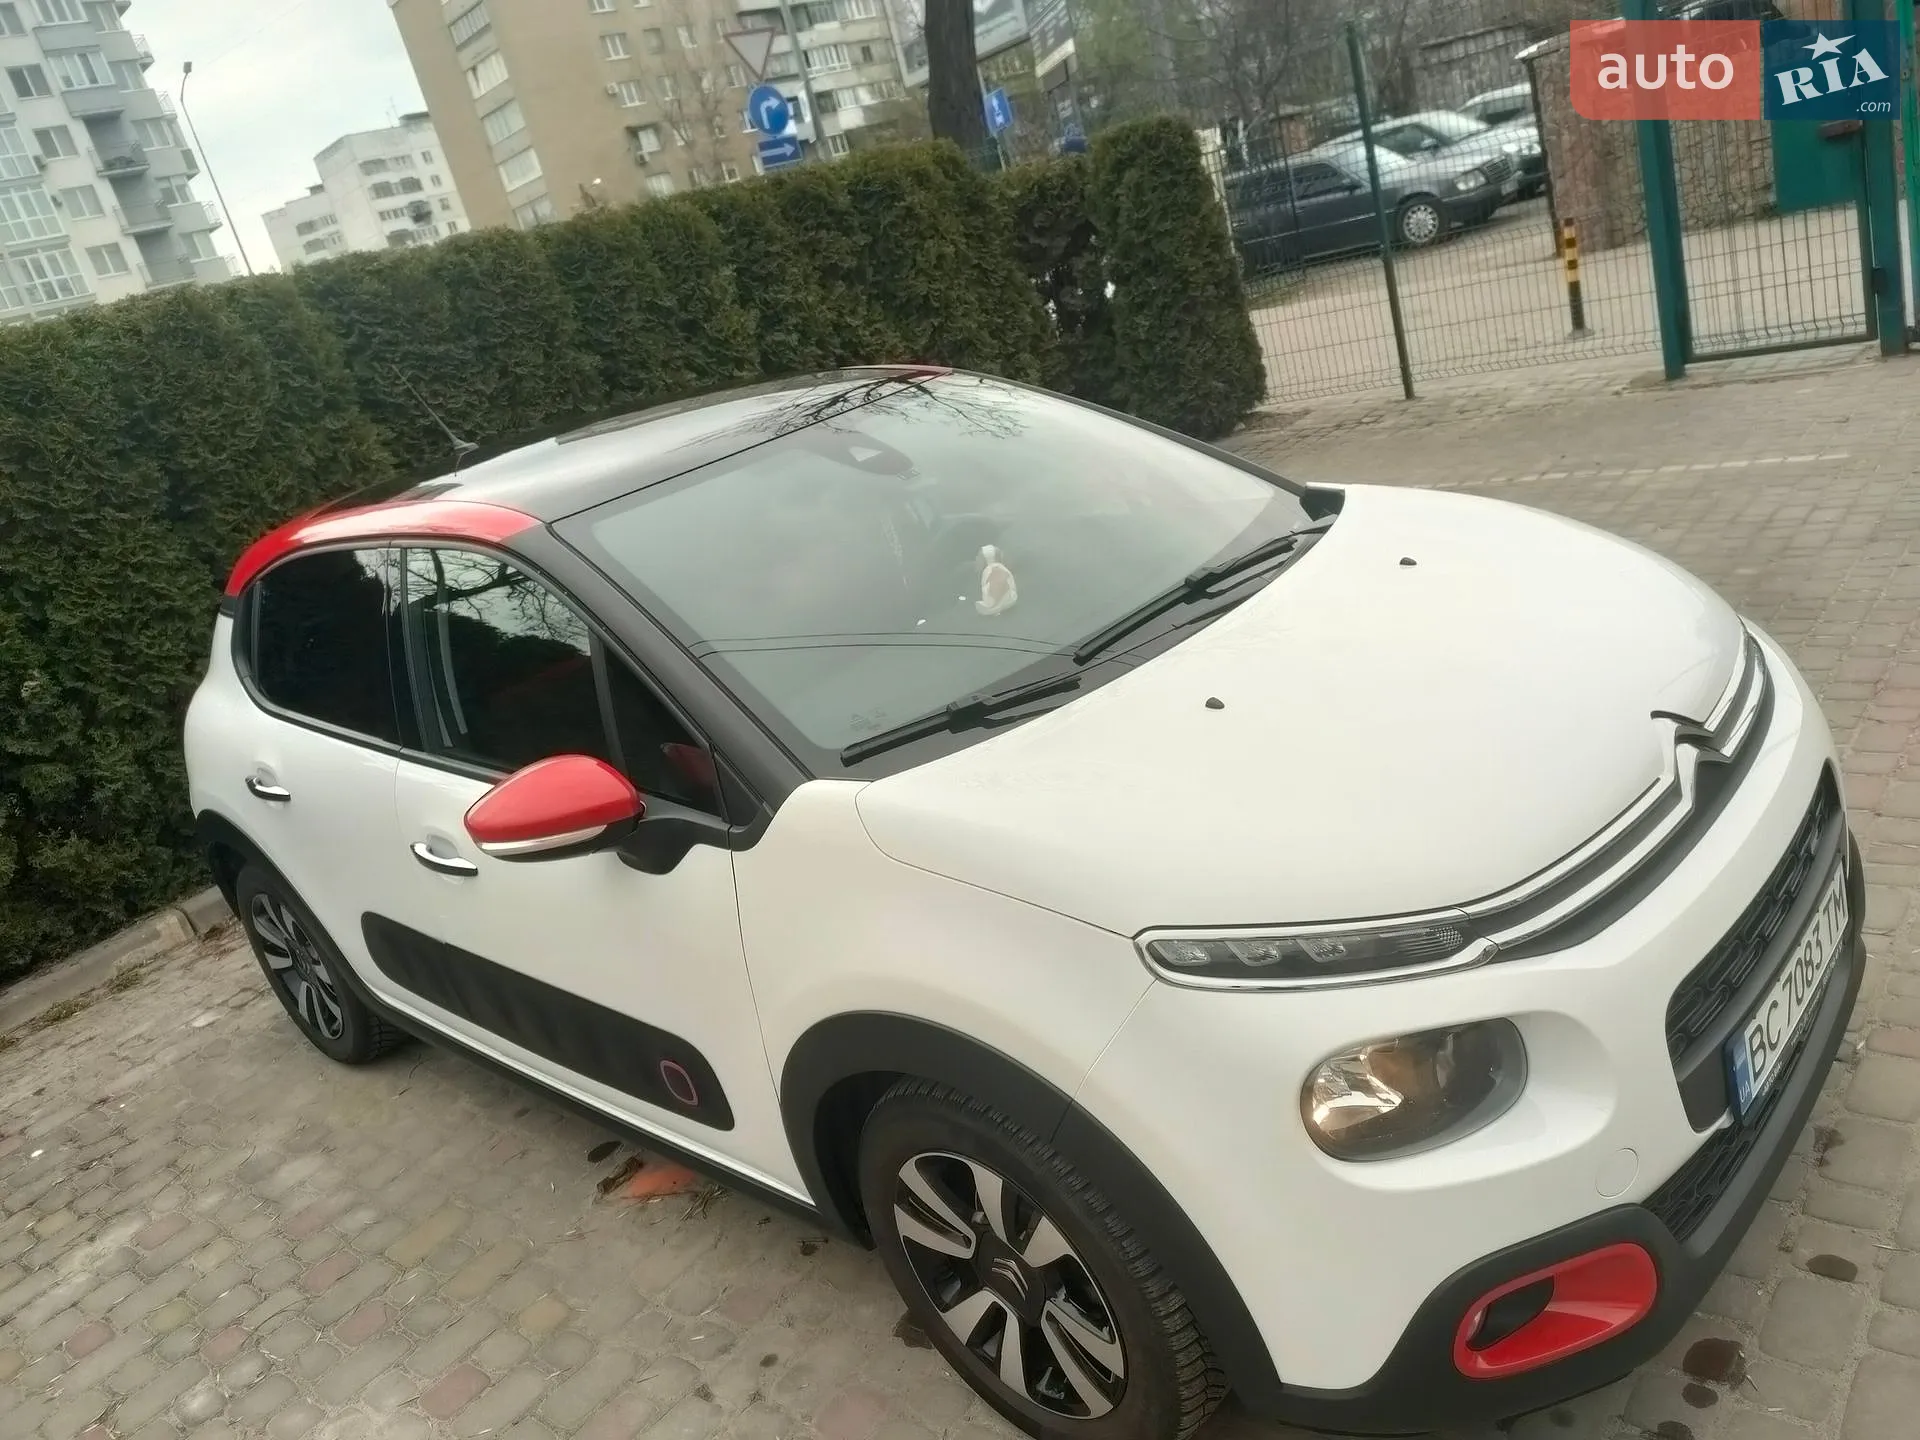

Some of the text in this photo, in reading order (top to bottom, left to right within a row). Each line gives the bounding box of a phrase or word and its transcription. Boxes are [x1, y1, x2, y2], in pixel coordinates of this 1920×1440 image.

[1749, 999, 1782, 1083] BC
[1782, 919, 1823, 1028] 7083
[1823, 872, 1846, 945] TM
[1739, 1080, 1751, 1103] UA
